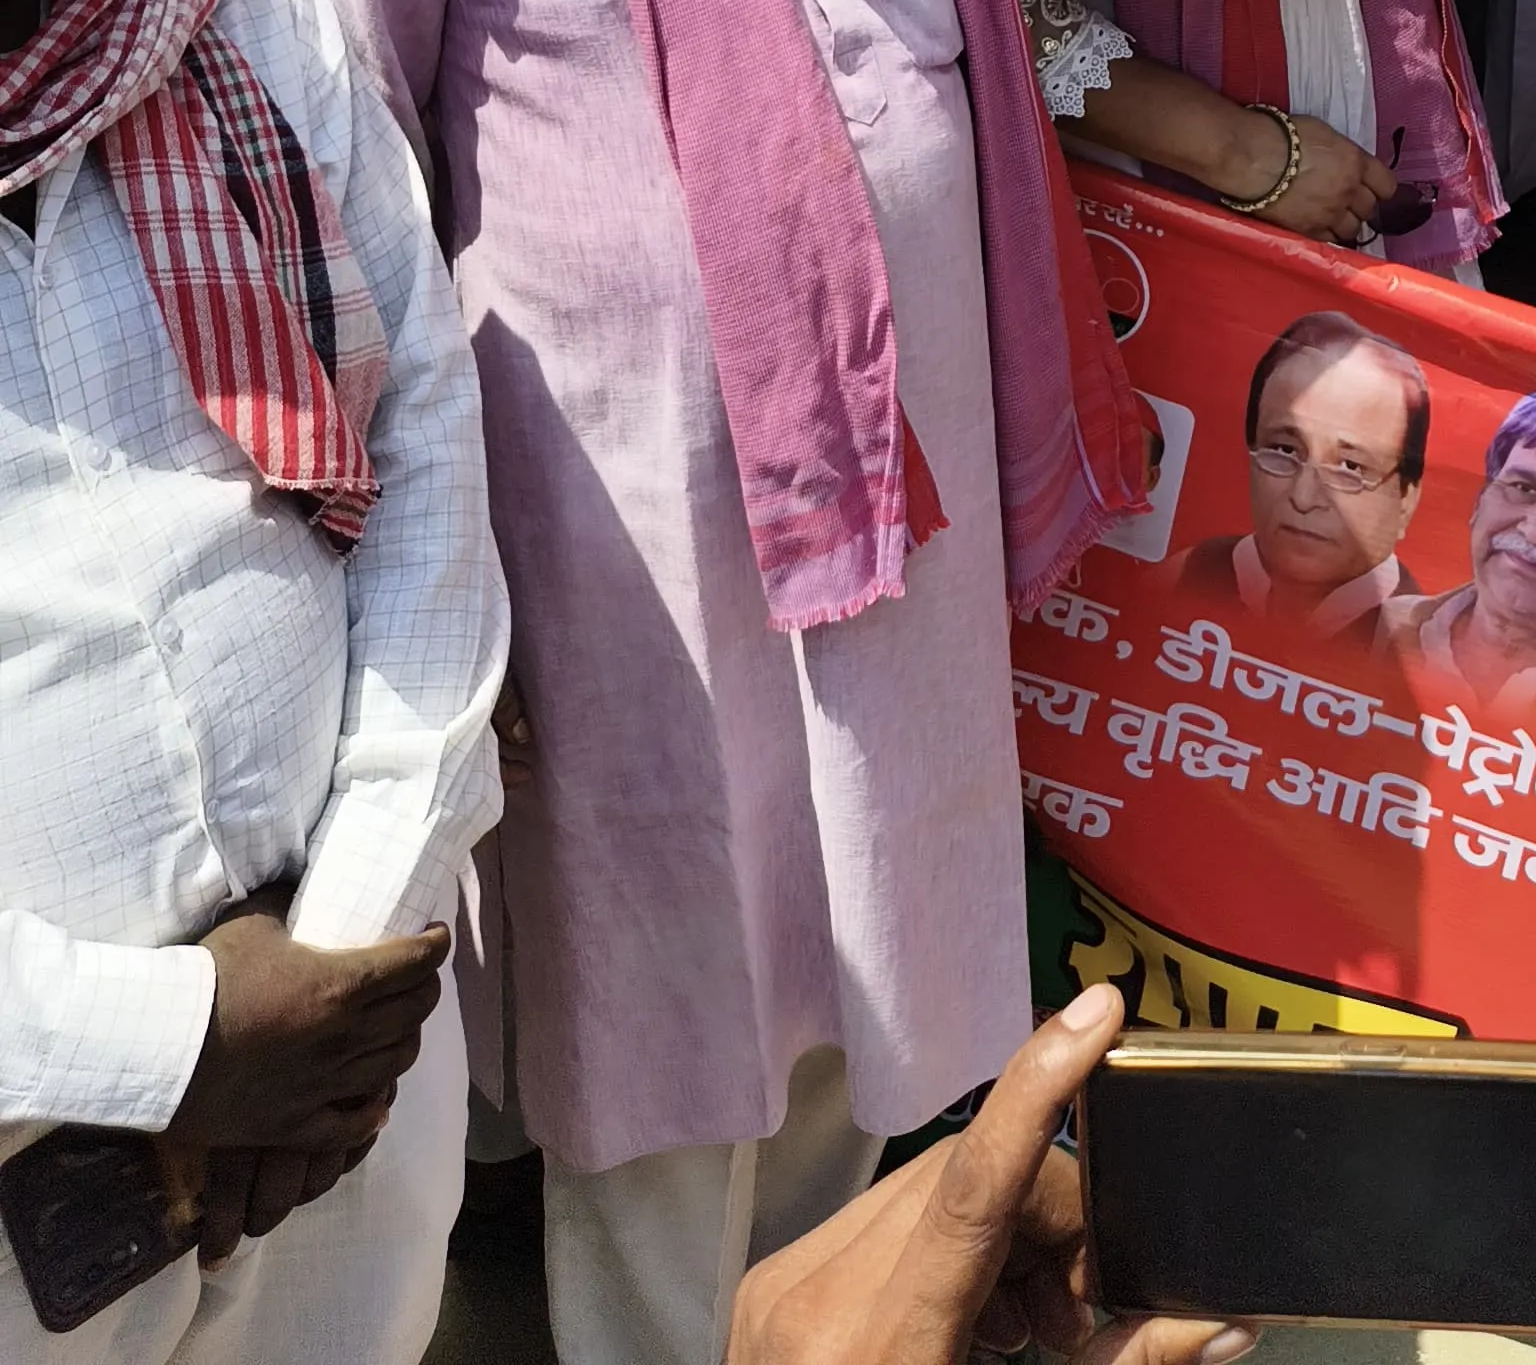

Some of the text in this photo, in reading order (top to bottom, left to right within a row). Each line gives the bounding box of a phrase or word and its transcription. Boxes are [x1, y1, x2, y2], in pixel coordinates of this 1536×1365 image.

[1019, 588, 1133, 660] क,
[1012, 669, 1099, 735] ल्य
[1107, 701, 1263, 791] वृद्धि
[1265, 757, 1443, 849] आदि
